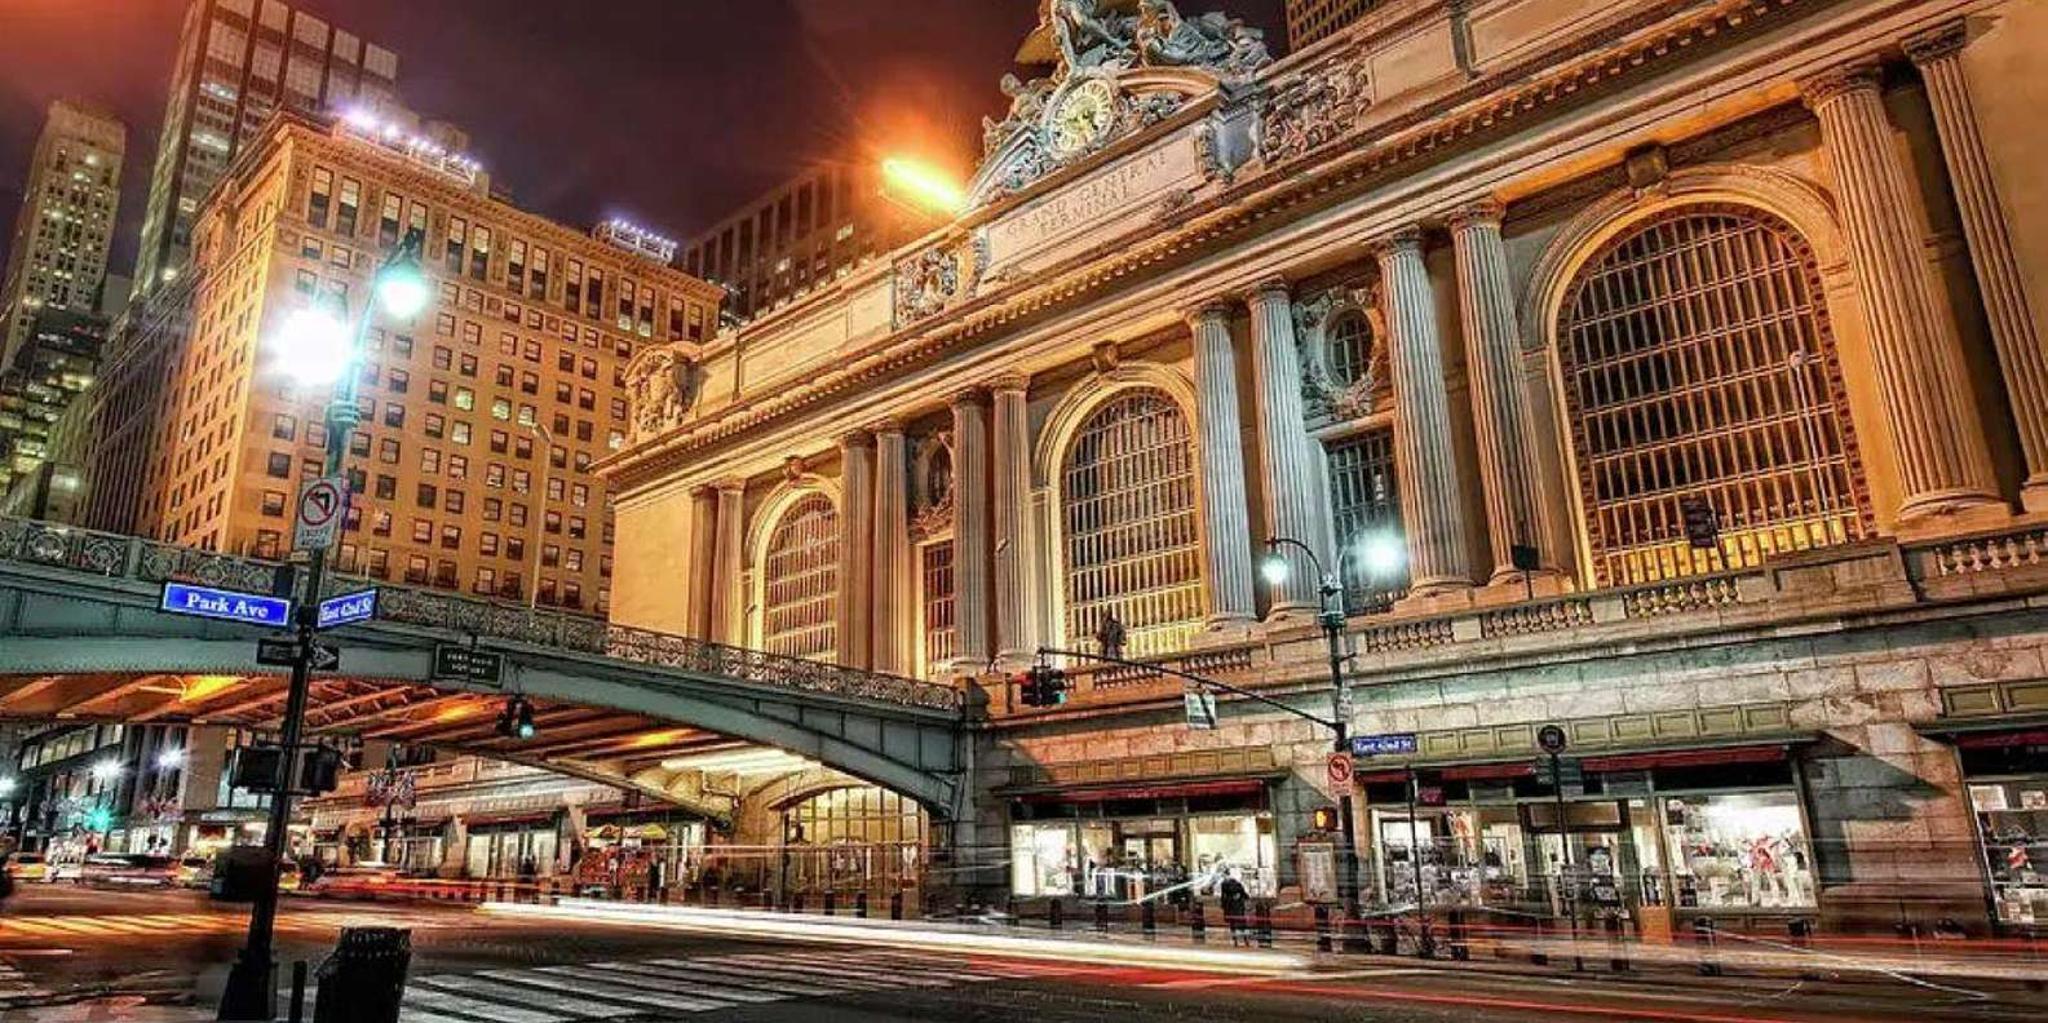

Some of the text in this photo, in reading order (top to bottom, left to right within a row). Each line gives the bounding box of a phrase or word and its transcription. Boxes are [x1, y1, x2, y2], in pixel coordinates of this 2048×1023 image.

[1006, 199, 1068, 237] GRAND
[185, 592, 269, 618] Park Ave
